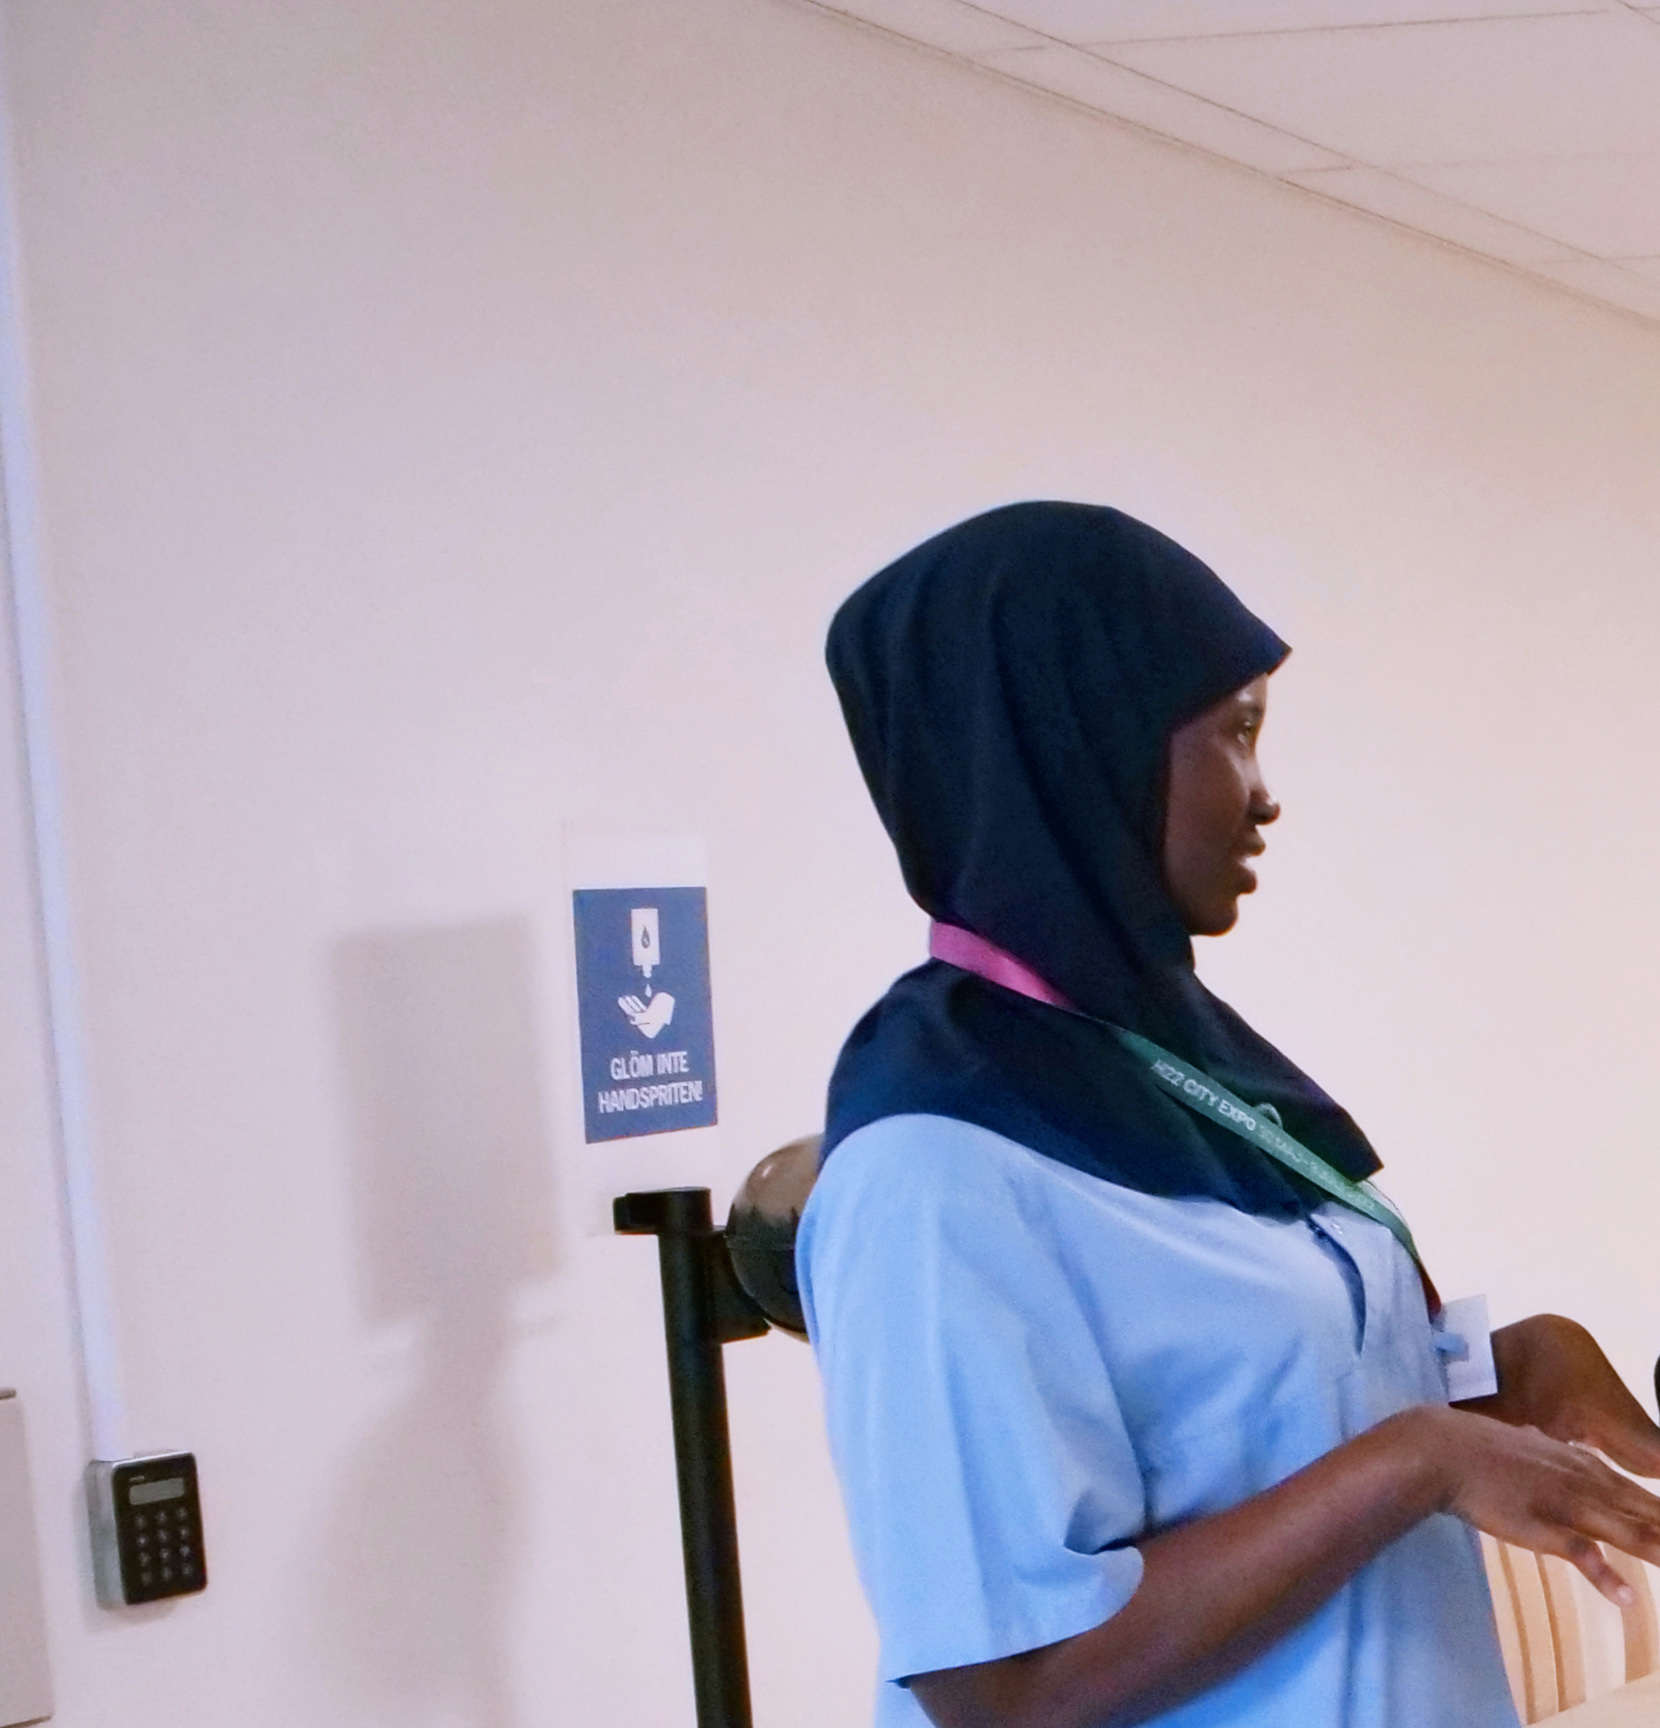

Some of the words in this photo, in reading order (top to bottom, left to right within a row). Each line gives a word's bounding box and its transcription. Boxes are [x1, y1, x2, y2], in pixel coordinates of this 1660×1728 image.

[610, 1050, 653, 1080] GLÖM
[657, 1051, 690, 1075] INTE
[1183, 1079, 1219, 1107] CITY
[1218, 1099, 1256, 1131] EXPO
